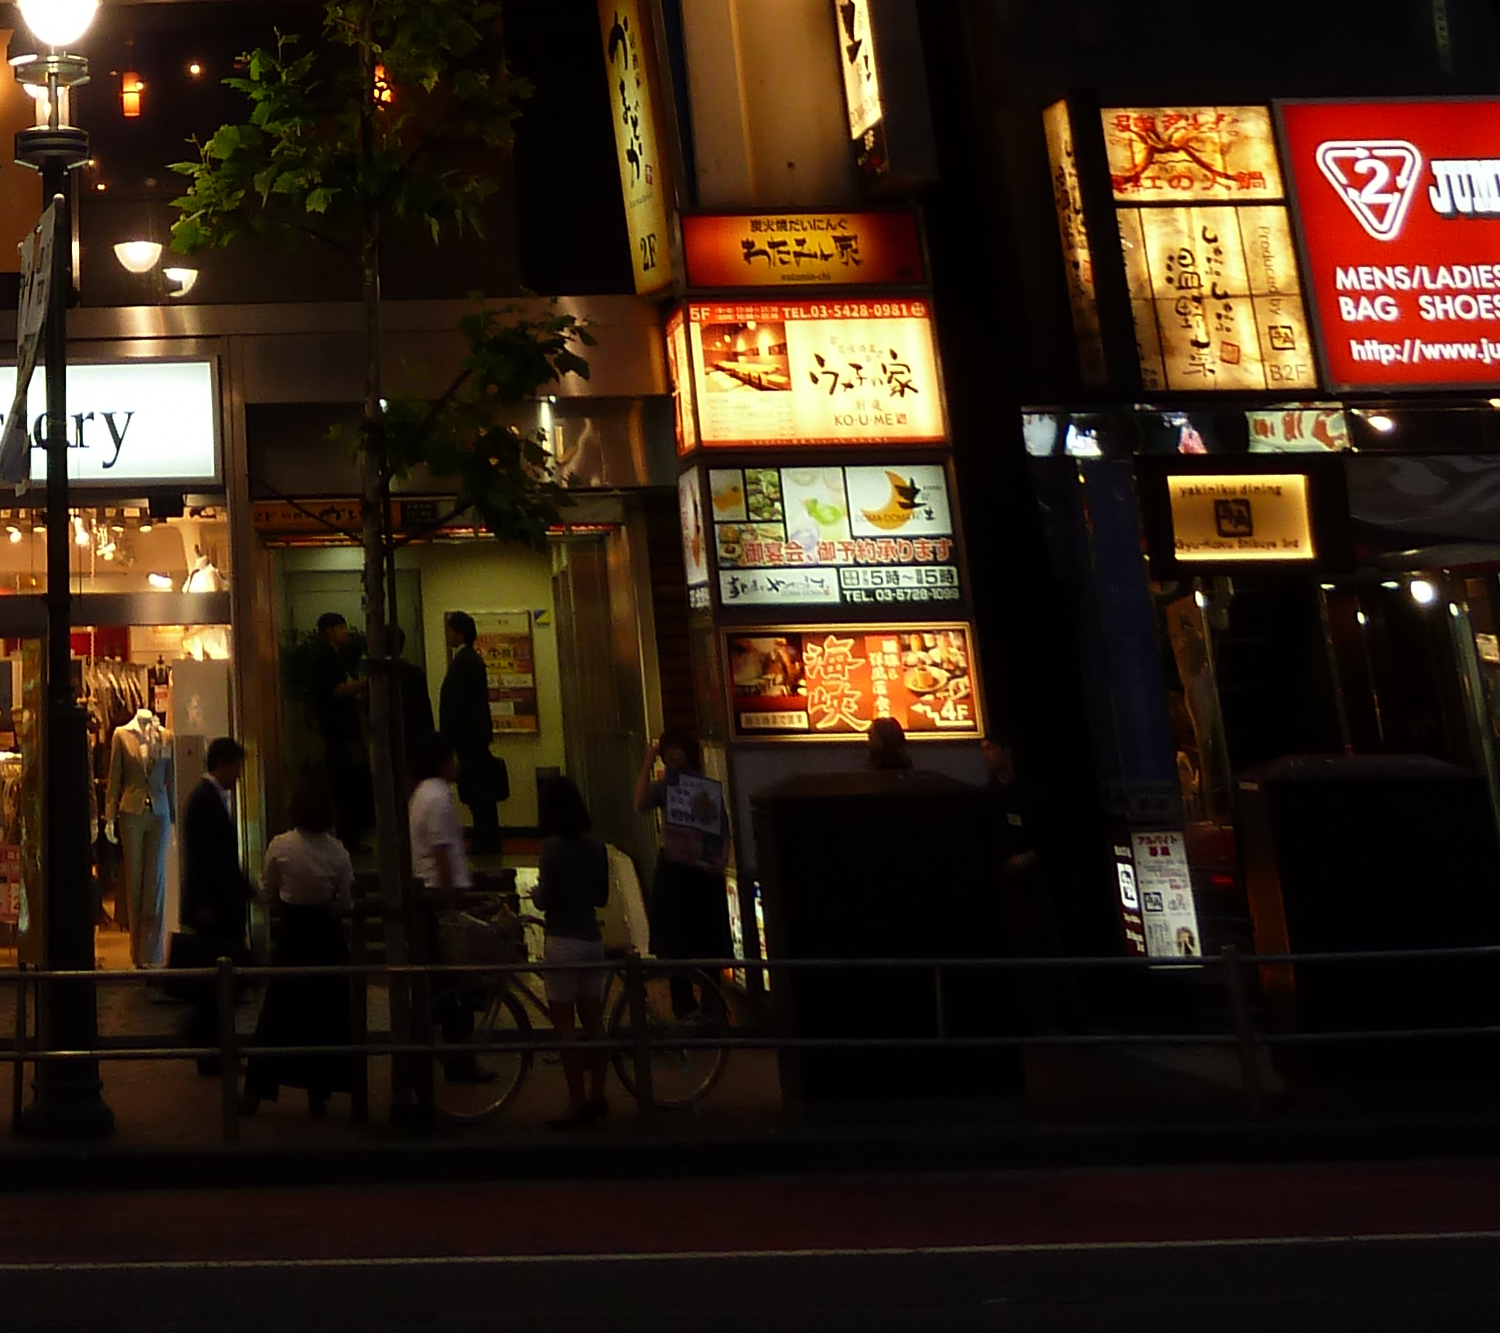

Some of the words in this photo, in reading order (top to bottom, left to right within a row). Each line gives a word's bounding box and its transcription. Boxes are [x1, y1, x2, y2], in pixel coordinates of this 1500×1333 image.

[749, 218, 849, 233] 炭火焼だいにんぐ
[639, 233, 658, 273] 2F
[741, 234, 865, 269] わたみん家
[1257, 225, 1280, 296] Produced
[689, 307, 711, 321] 5F
[1267, 297, 1284, 317] by
[1339, 295, 1399, 322] BAG
[1270, 363, 1308, 382] B2F
[1180, 484, 1237, 498] yakiniku
[1239, 483, 1283, 497] dining
[742, 537, 955, 565] 御宴会、御予約承ります
[842, 589, 875, 602] TEL.
[941, 699, 969, 721] 4F
